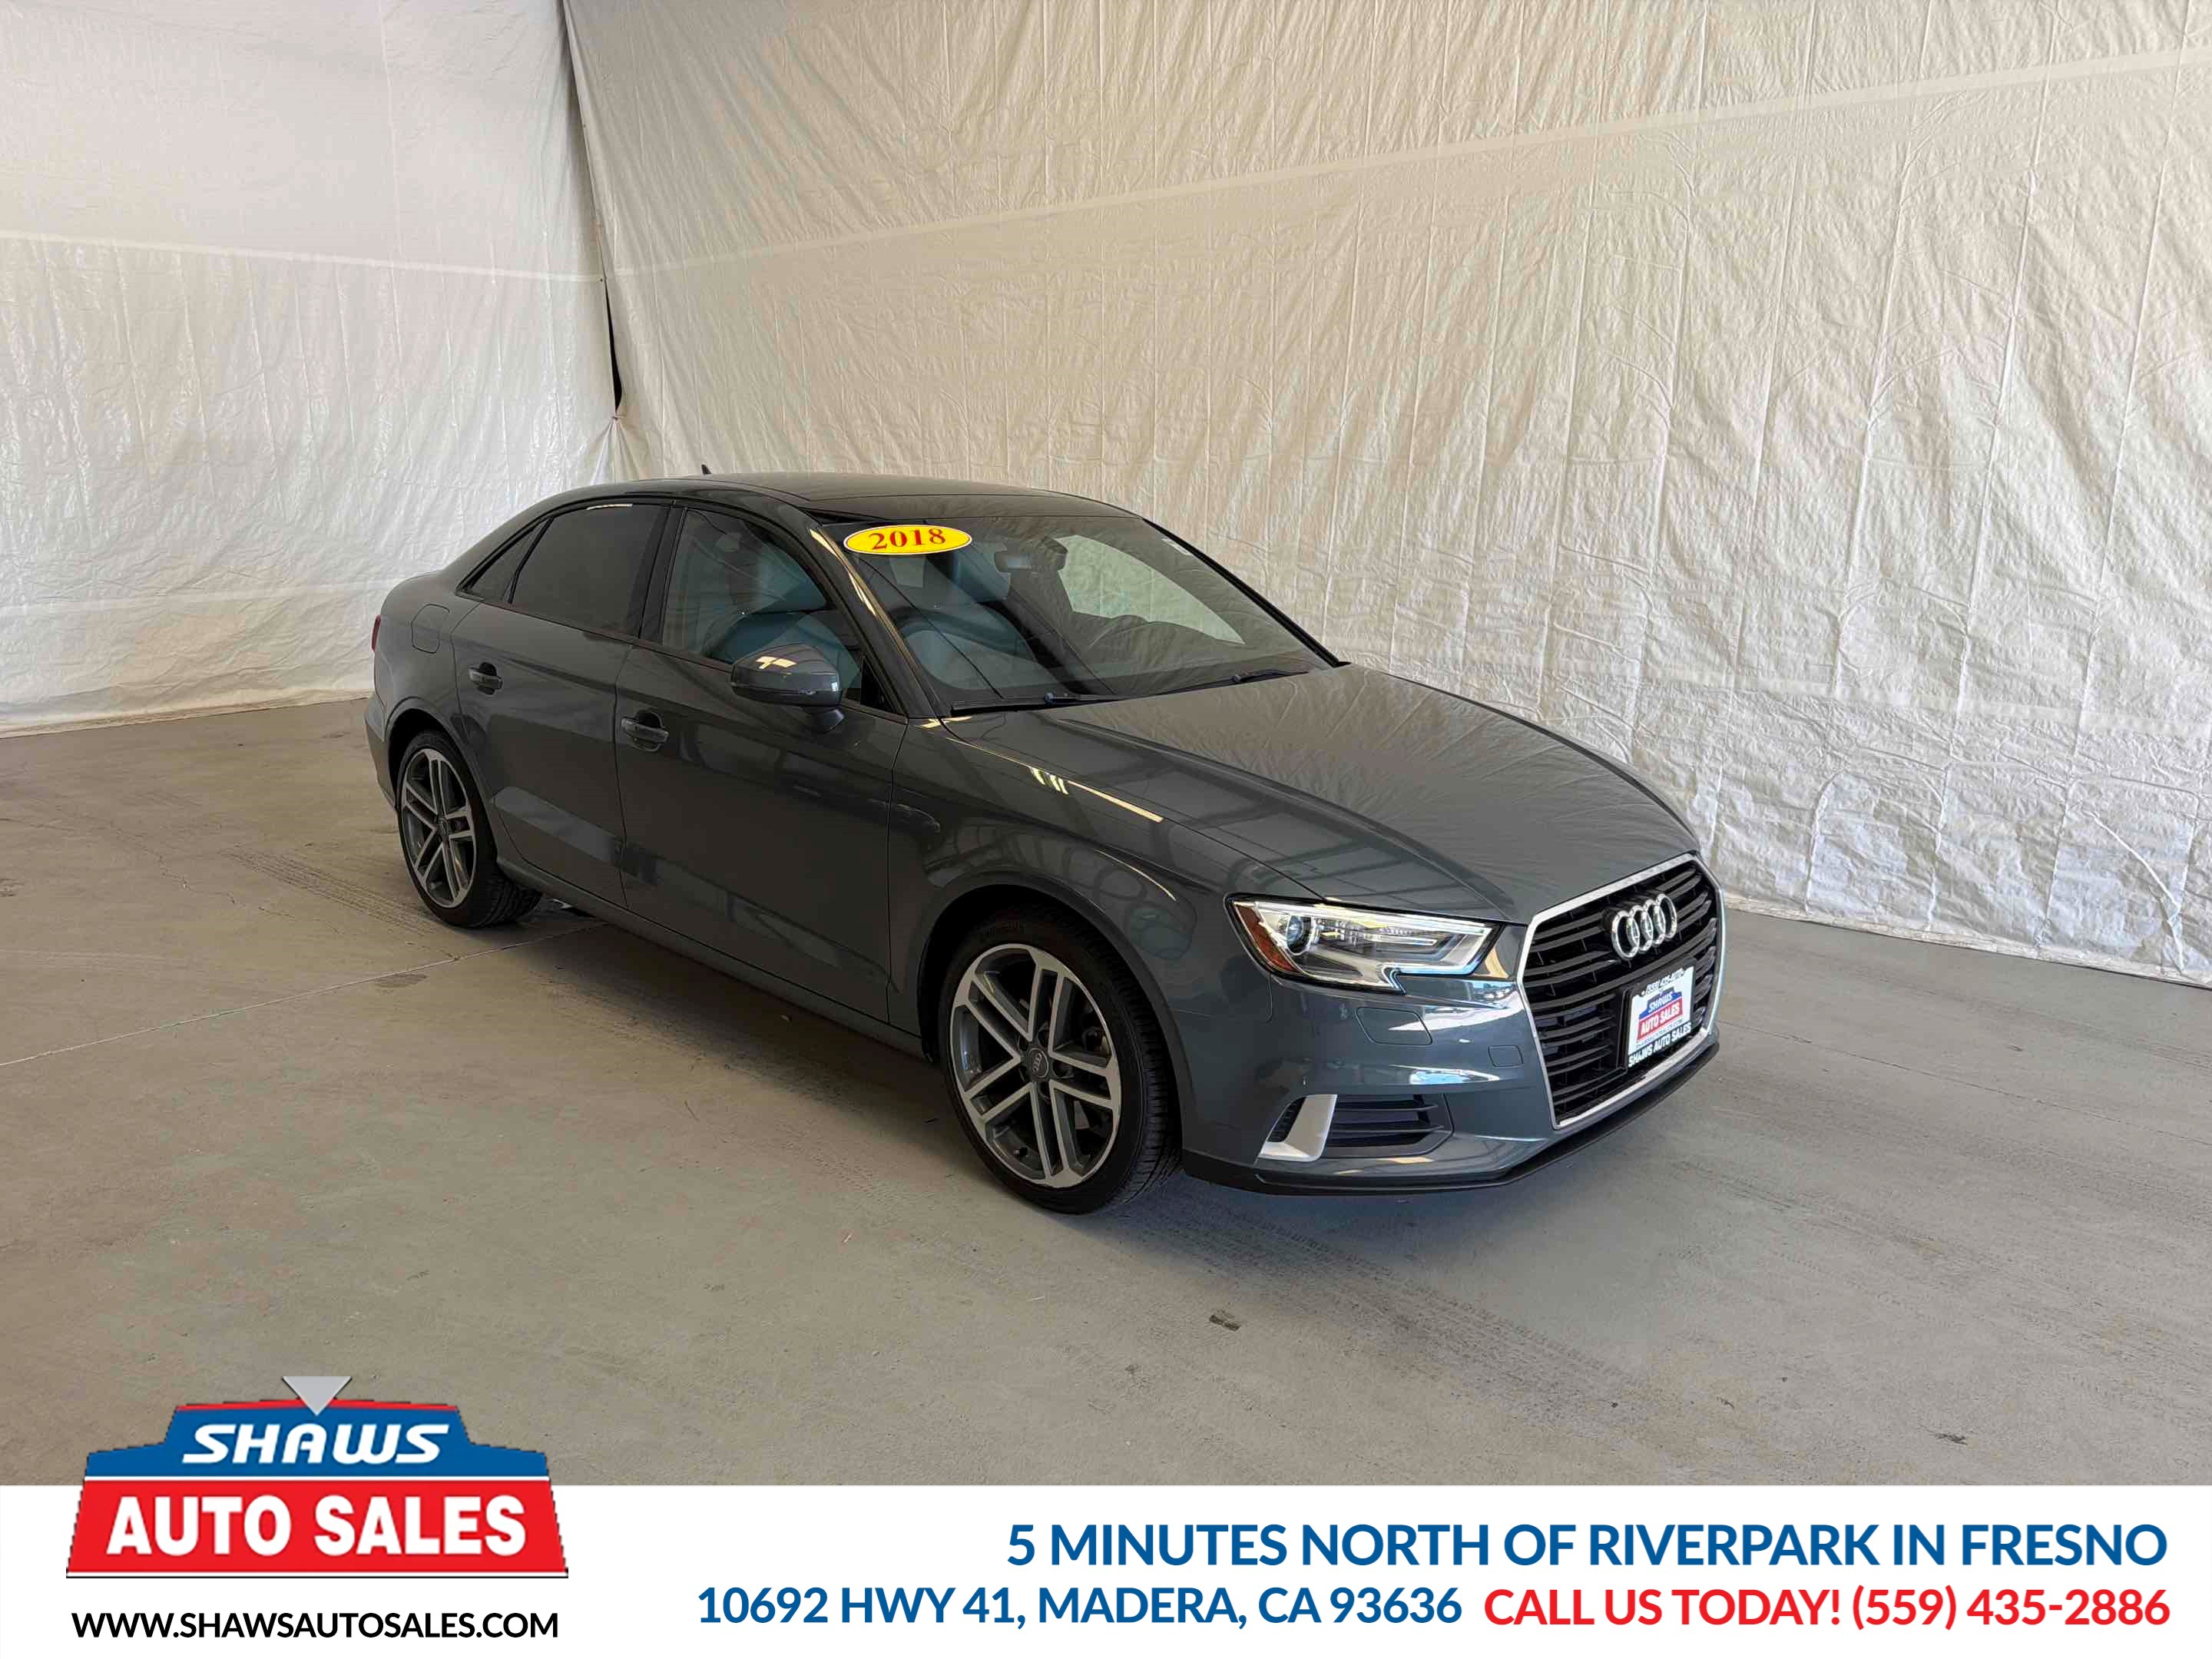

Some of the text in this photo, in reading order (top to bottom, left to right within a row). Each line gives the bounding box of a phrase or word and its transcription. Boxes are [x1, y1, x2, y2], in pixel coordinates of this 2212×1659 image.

[868, 528, 946, 550] 2018
[1641, 1013, 1659, 1035] AUTO
[1659, 1002, 1680, 1026] SALES
[1653, 1035, 1671, 1052] AUTO
[1671, 1022, 1692, 1042] SALES
